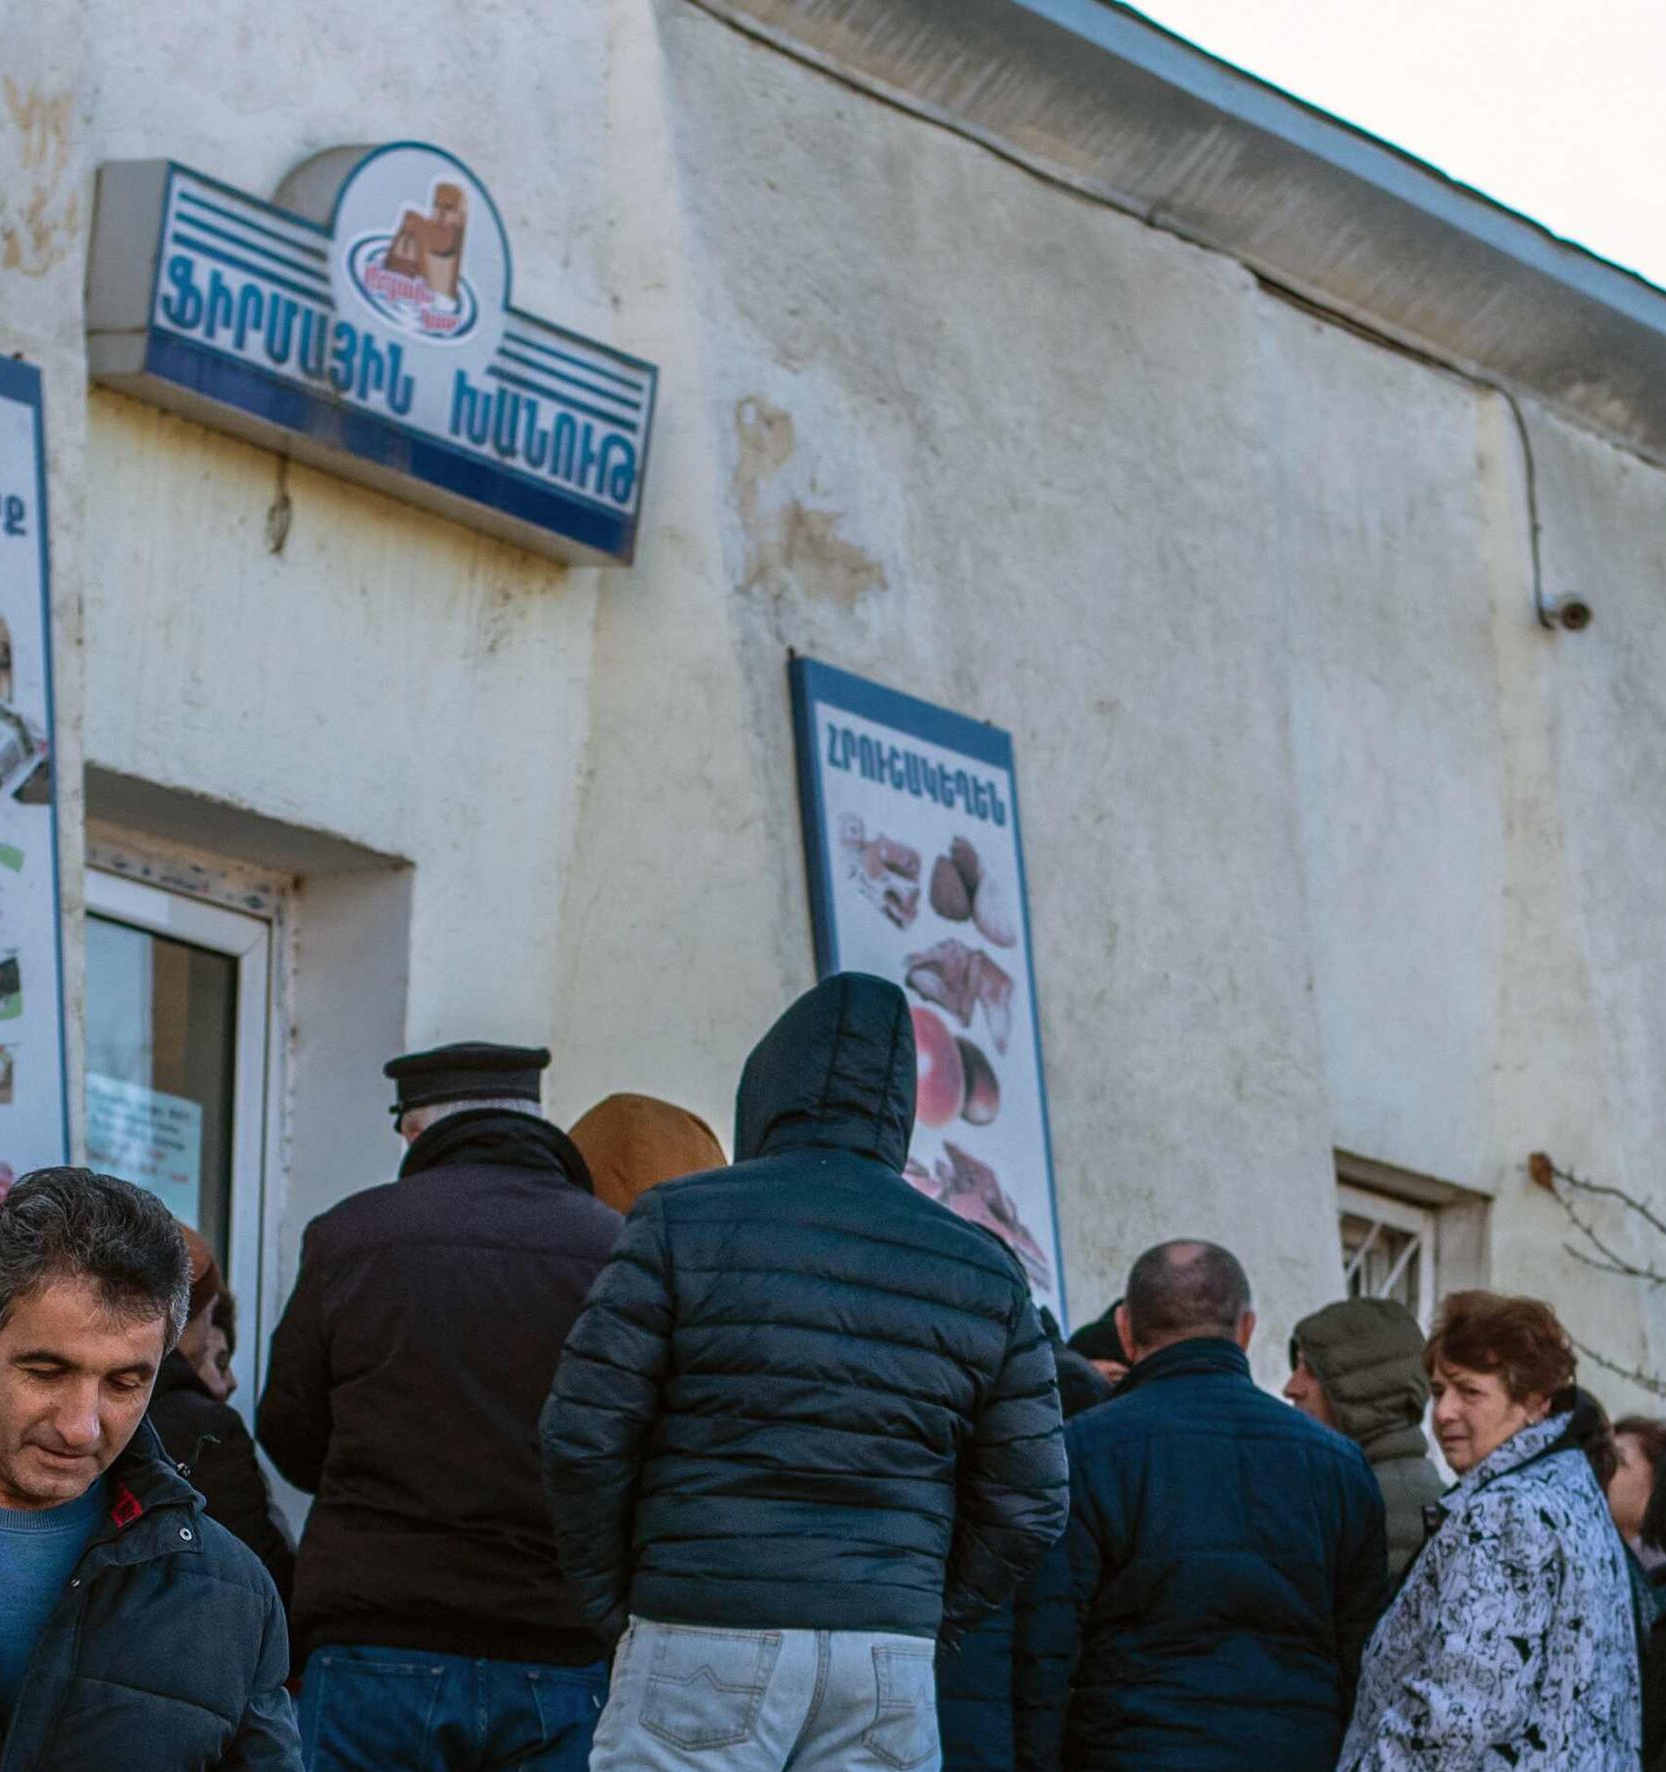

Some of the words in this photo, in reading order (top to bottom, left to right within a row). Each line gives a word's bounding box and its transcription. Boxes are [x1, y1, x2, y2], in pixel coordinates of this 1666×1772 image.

[161, 255, 414, 417] ՖԻՐՄԱՅԻՆ
[449, 368, 635, 504] ԽԱՆՈՒԹ
[827, 720, 1006, 828] ՀՐՈՒՇԱԿԵՂԵՆ
